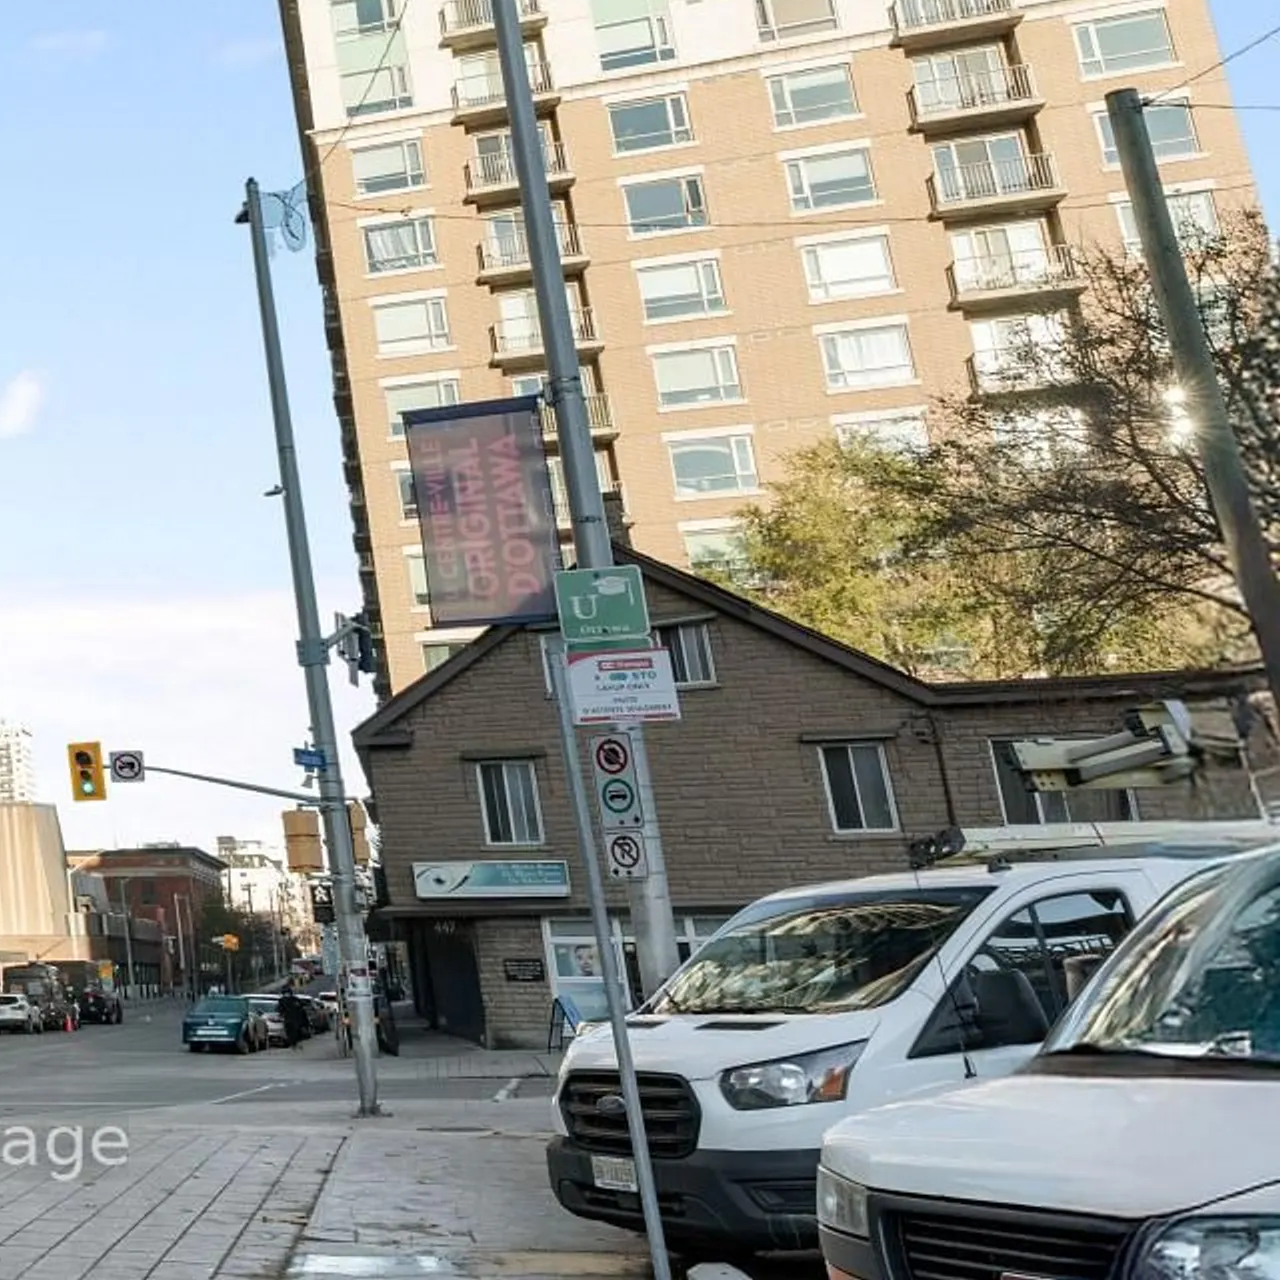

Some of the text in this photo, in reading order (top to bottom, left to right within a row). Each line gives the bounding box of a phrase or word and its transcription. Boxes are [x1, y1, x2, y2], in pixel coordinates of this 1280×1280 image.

[448, 437, 499, 599] ORIGINAL
[488, 433, 540, 595] D'OTTAWA
[570, 595, 598, 620] U
